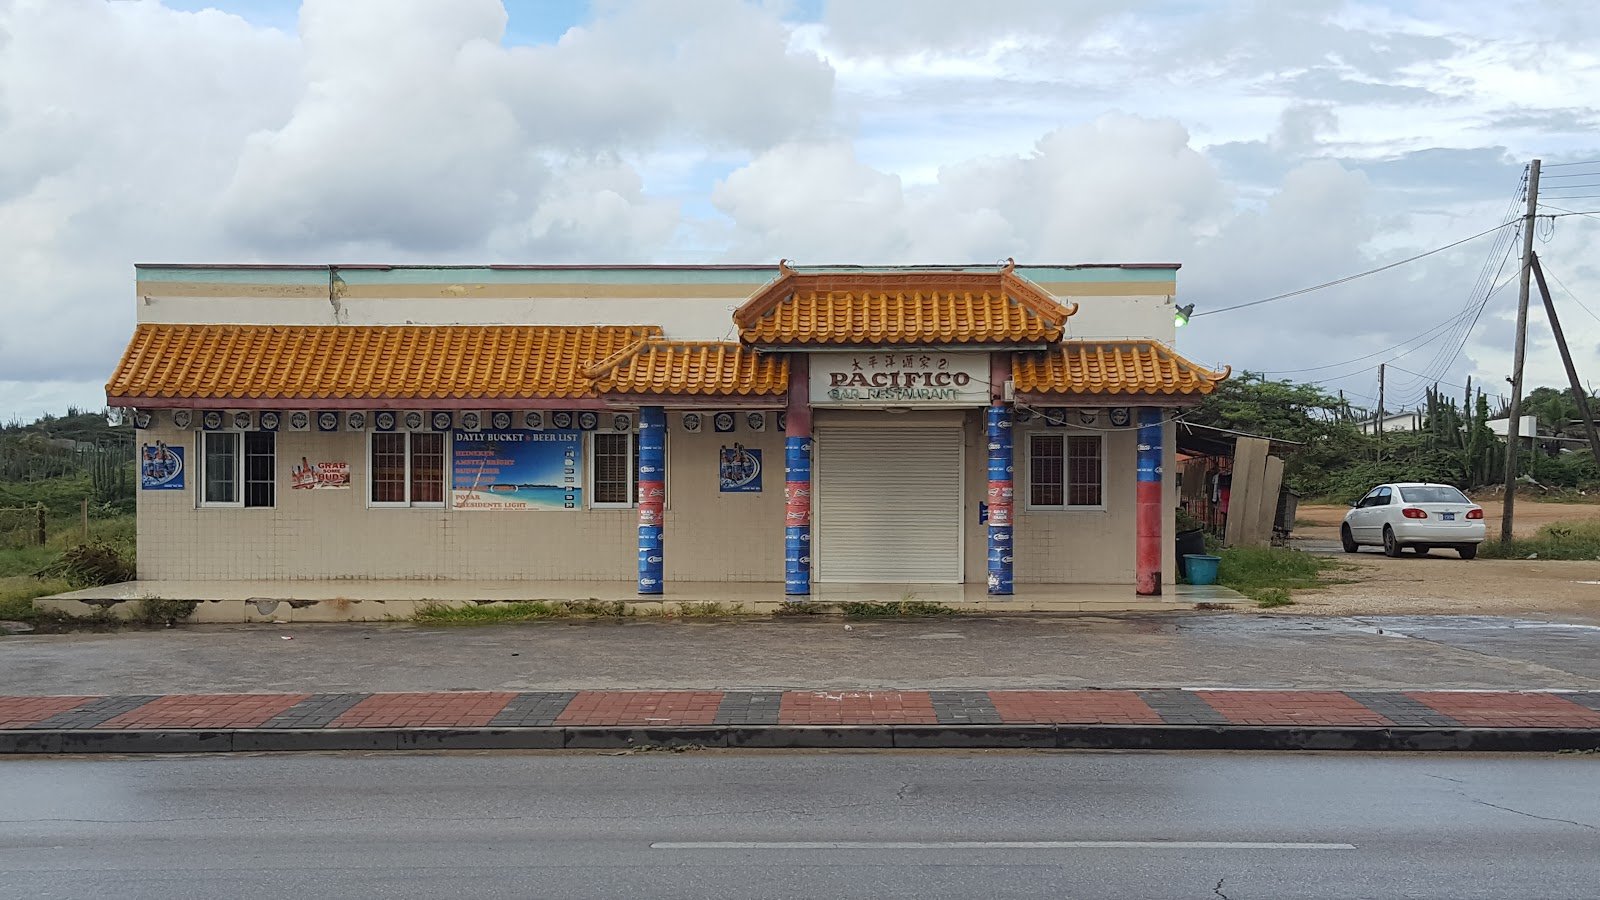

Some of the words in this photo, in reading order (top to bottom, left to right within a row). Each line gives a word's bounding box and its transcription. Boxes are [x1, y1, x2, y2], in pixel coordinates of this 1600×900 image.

[829, 372, 970, 388] PACIFICO
[828, 388, 860, 400] BAR
[868, 387, 958, 400] RESTAURANT
[456, 433, 485, 441] DAYLY
[488, 433, 524, 441] BUCKET
[533, 433, 557, 441] BEER
[559, 433, 578, 441] LIST
